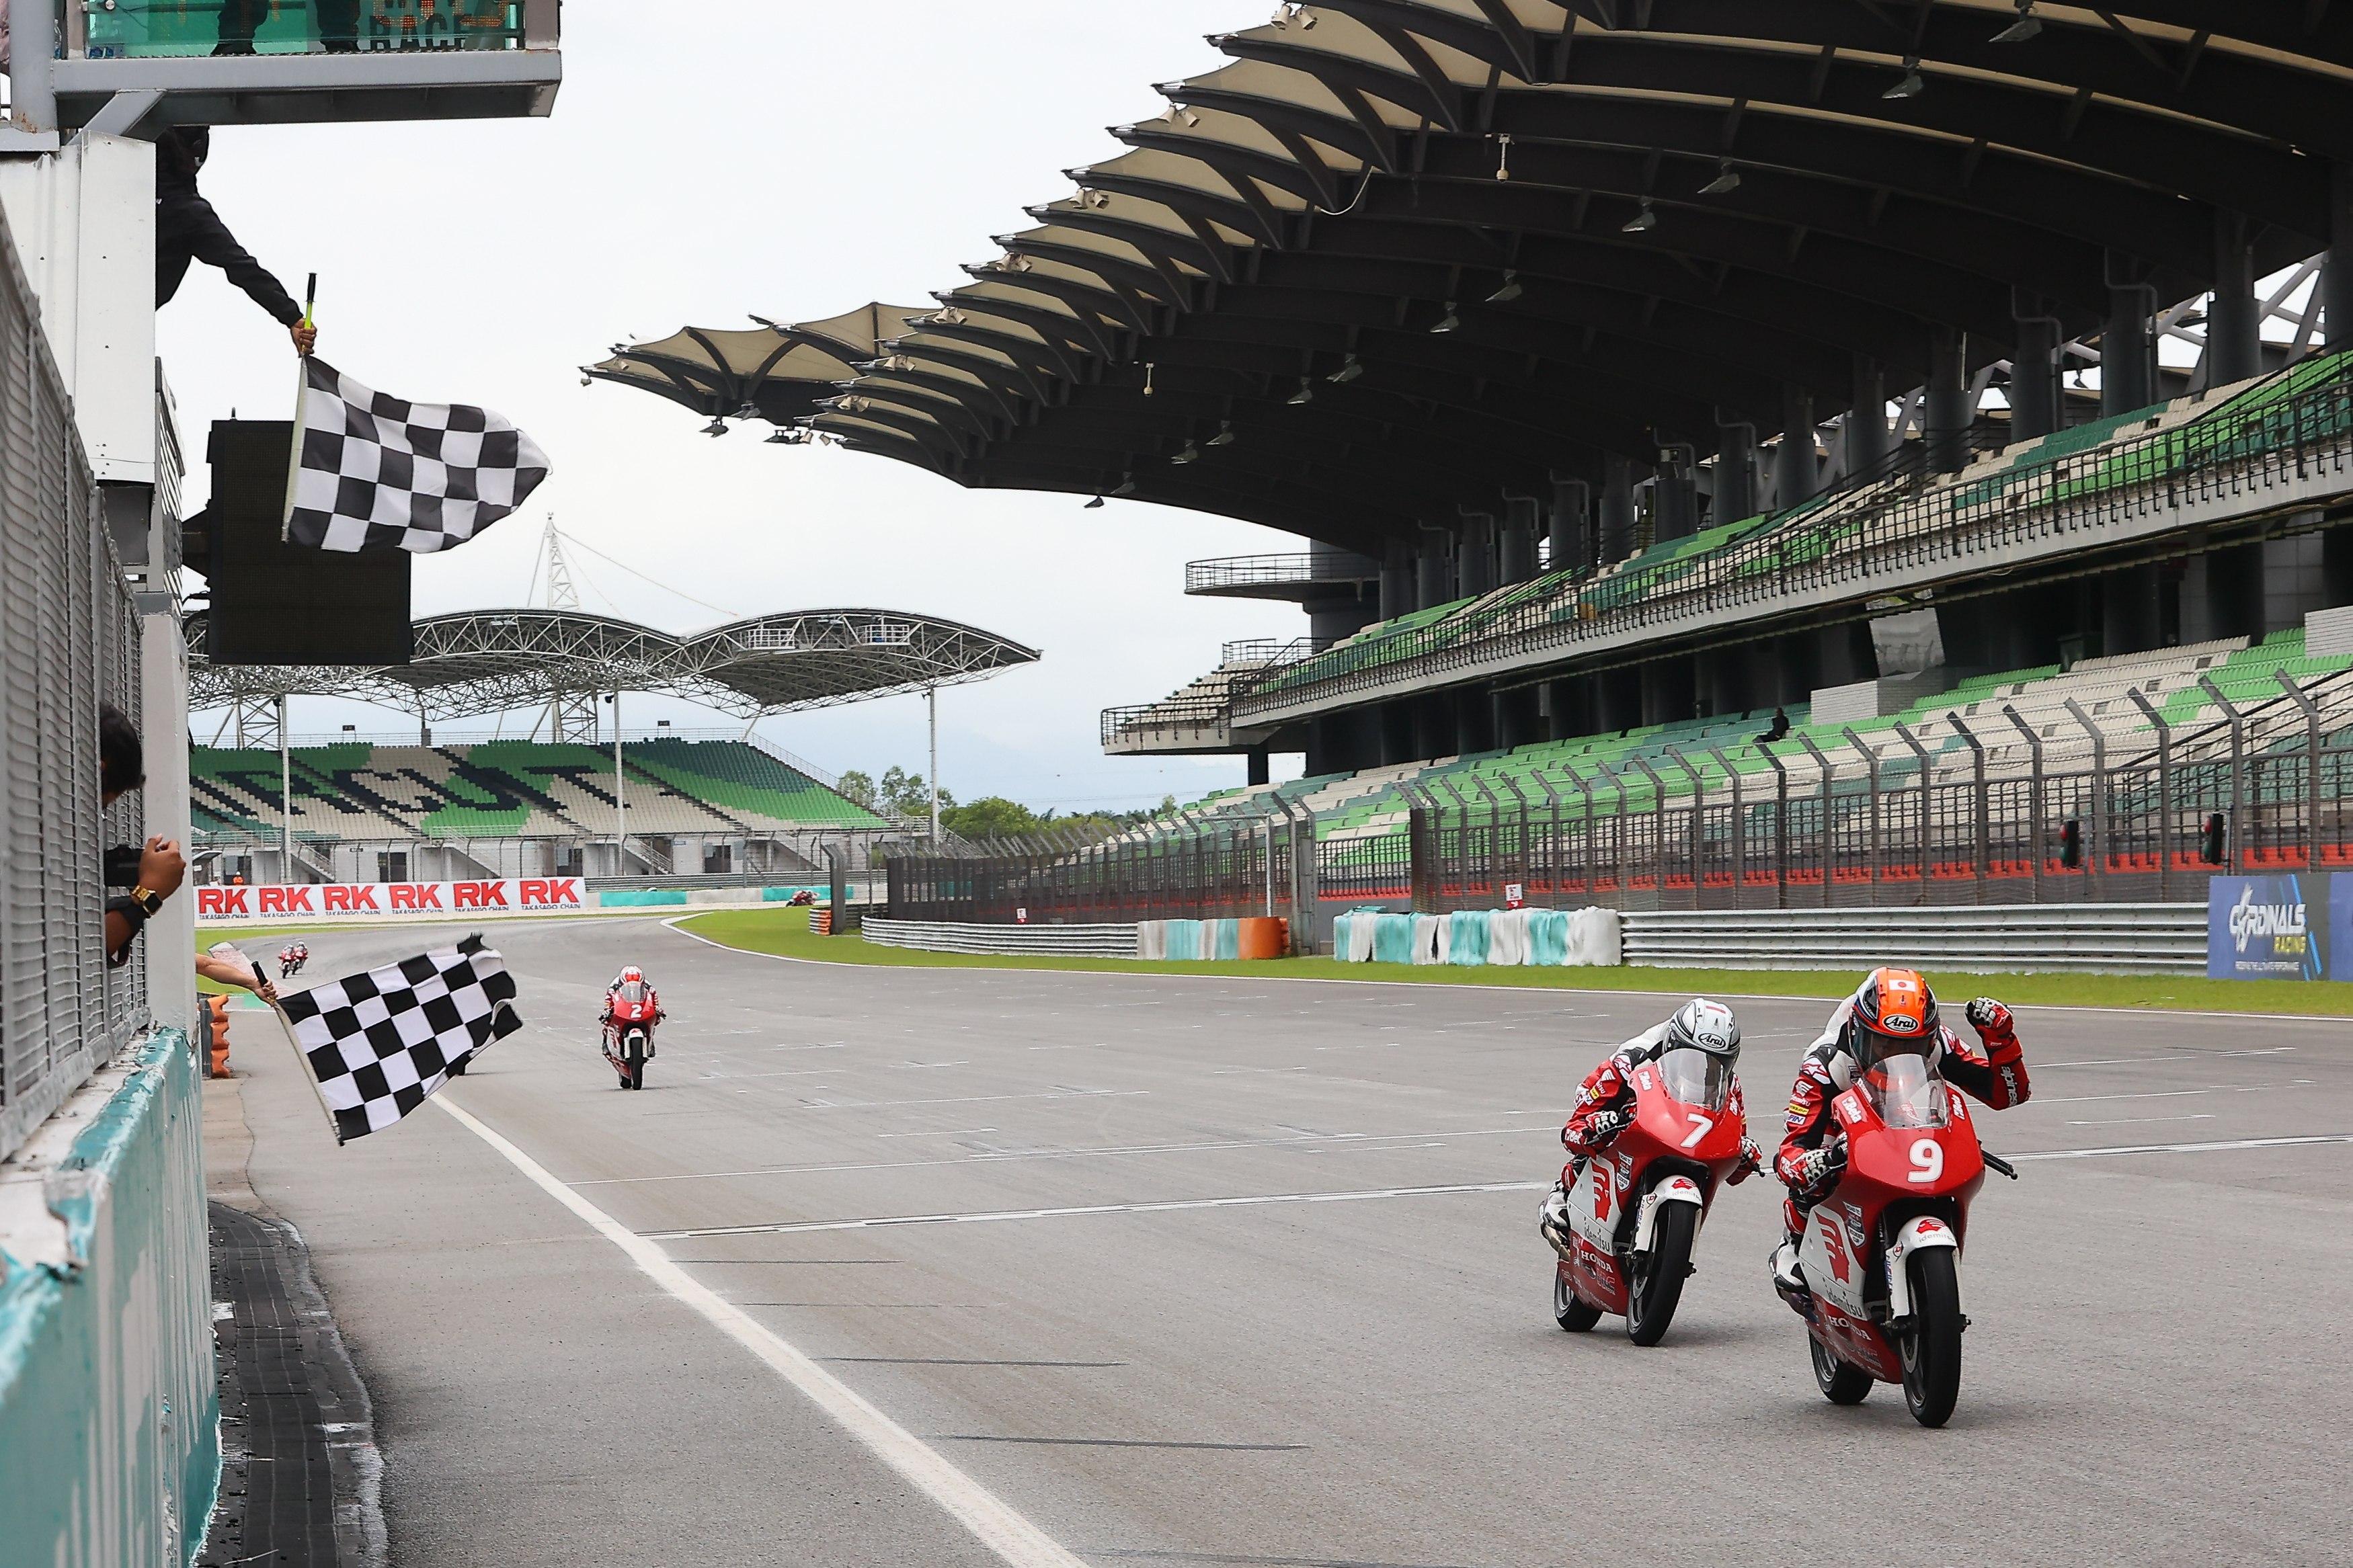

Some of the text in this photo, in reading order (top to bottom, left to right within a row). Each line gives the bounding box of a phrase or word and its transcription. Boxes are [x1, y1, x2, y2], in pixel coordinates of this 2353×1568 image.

[198, 889, 249, 913] RK
[259, 887, 314, 912] RK
[323, 886, 379, 910] RK
[389, 884, 443, 909] RK
[453, 881, 508, 907] RK
[520, 879, 580, 905] RK
[631, 1004, 642, 1018] 2
[1886, 1018, 1915, 1028] Arai
[1700, 1035, 1723, 1046] Arai
[1844, 1102, 1862, 1123] Beta
[1680, 1112, 1713, 1148] 7
[1907, 1138, 1944, 1183] 9
[1581, 1251, 1613, 1273] HONDA
[1827, 1315, 1872, 1341] HONDA
